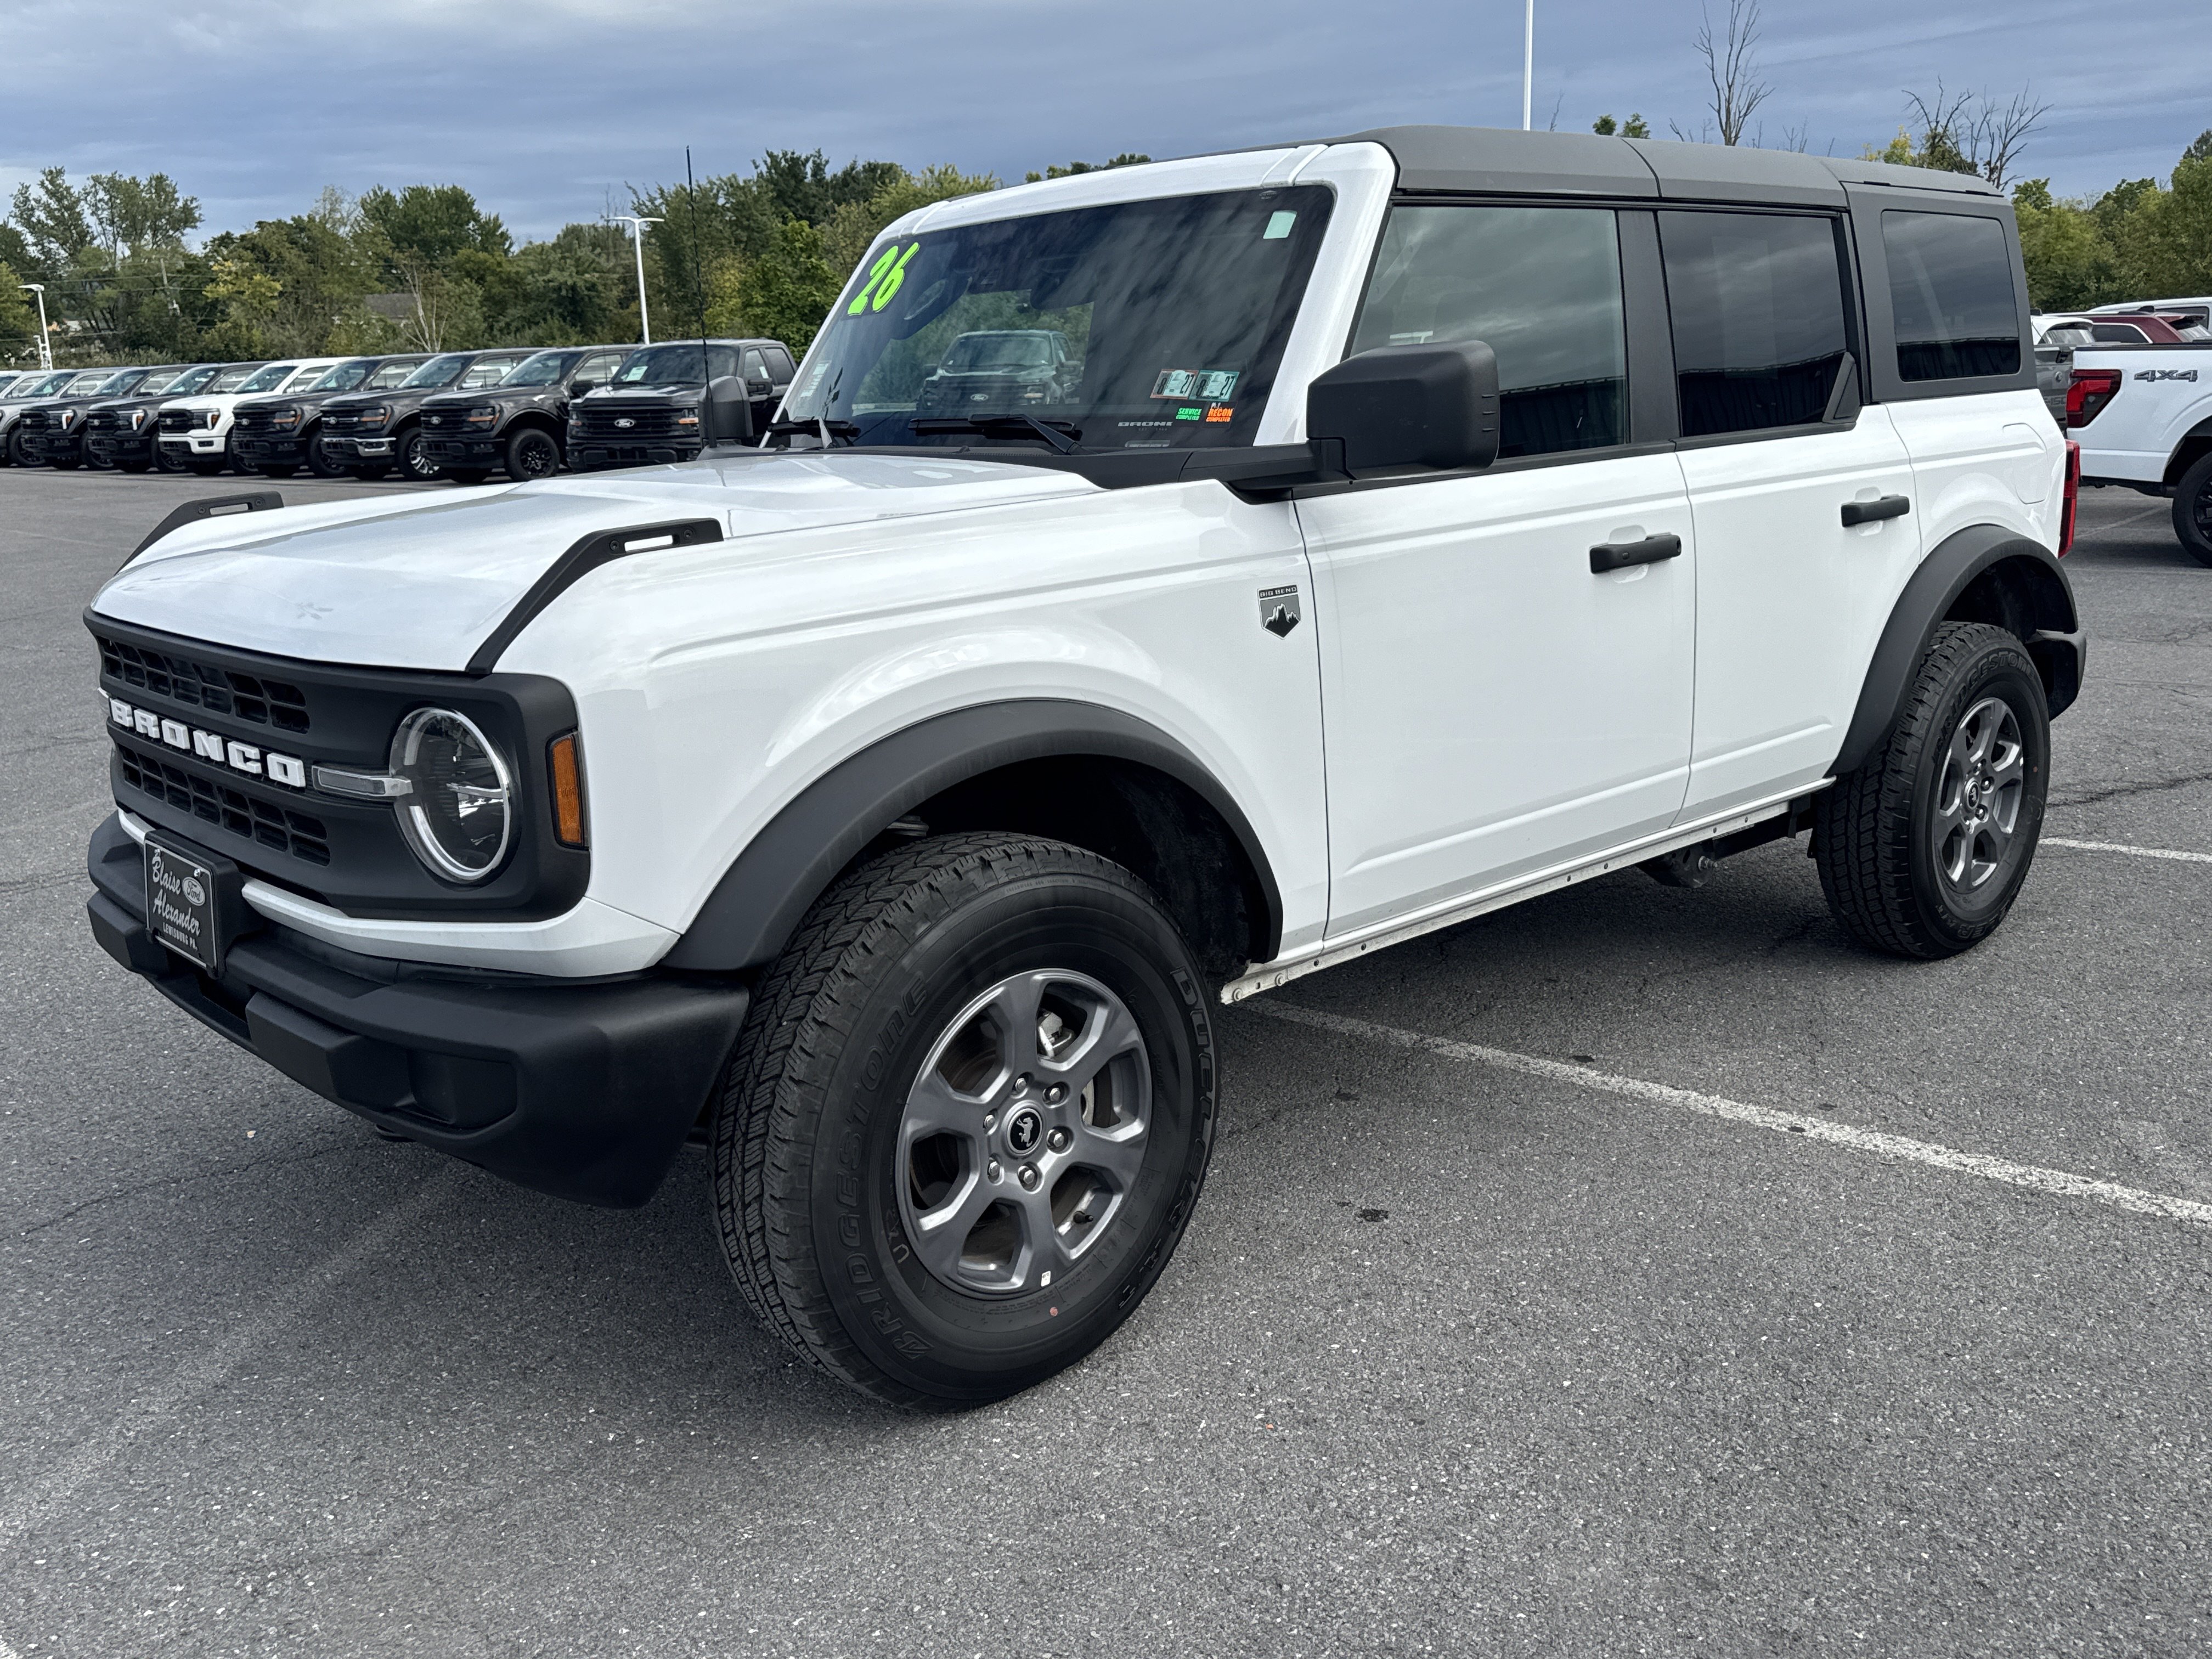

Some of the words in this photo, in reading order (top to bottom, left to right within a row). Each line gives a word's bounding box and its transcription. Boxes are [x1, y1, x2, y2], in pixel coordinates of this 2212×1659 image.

[848, 242, 919, 316] 26
[1156, 377, 1167, 394] 8
[1180, 374, 1194, 394] 27
[1195, 379, 1206, 397] 8
[1220, 376, 1235, 396] 27
[1208, 408, 1233, 417] RECON
[111, 698, 306, 787] BRONCO
[152, 856, 181, 895] Blaise
[185, 879, 202, 902] Ford
[153, 889, 200, 936] Alexander
[163, 922, 188, 945] LEWISBURG
[1169, 966, 1214, 1232] DUELER
[837, 974, 935, 1361] BRIDGESTONE
